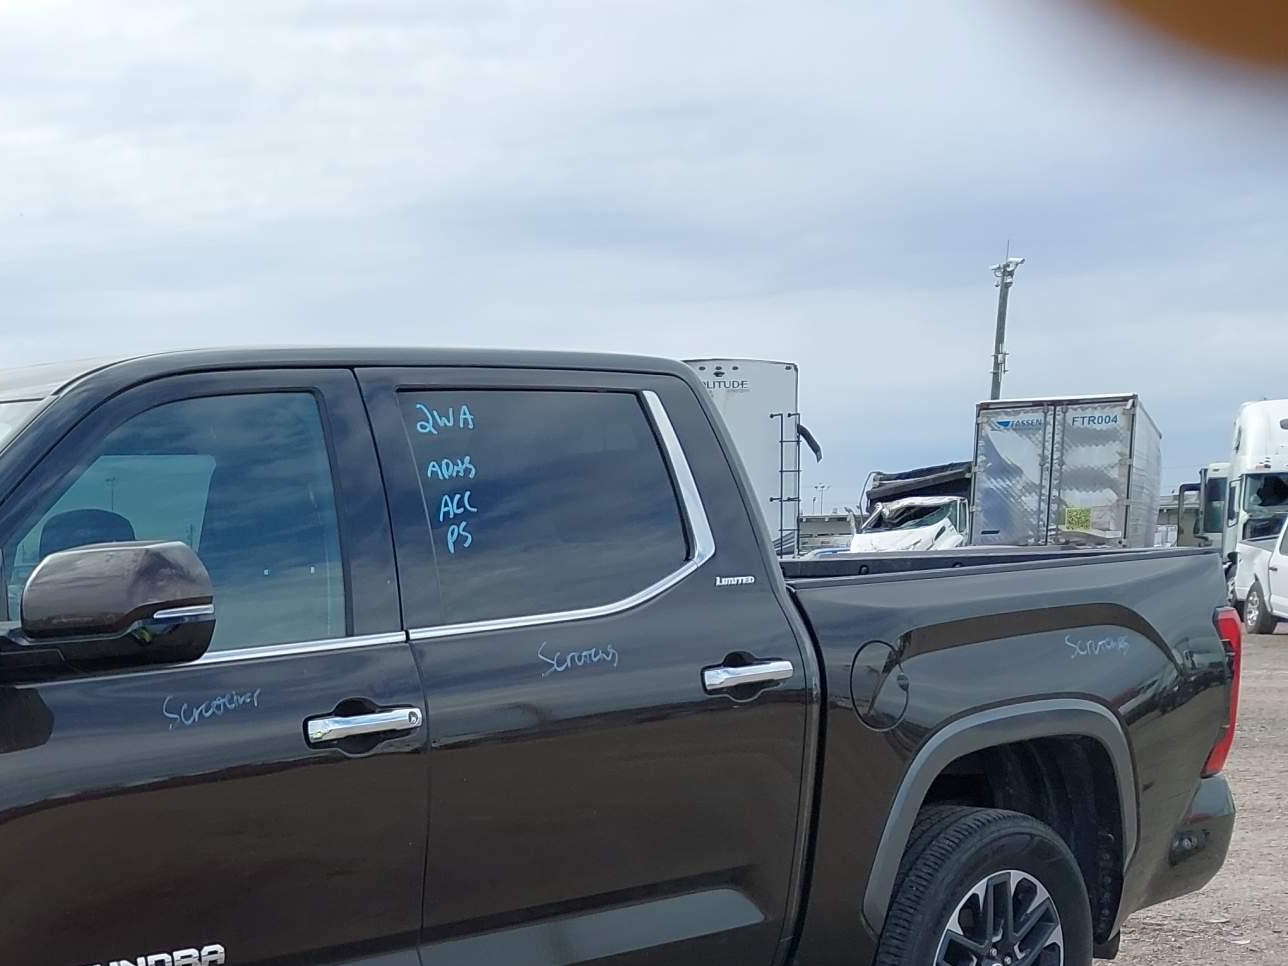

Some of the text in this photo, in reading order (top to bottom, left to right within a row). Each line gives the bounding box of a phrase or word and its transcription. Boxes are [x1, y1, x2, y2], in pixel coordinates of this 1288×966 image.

[1072, 415, 1119, 426] FTR004
[439, 490, 478, 522] ACC
[447, 521, 472, 554] PS
